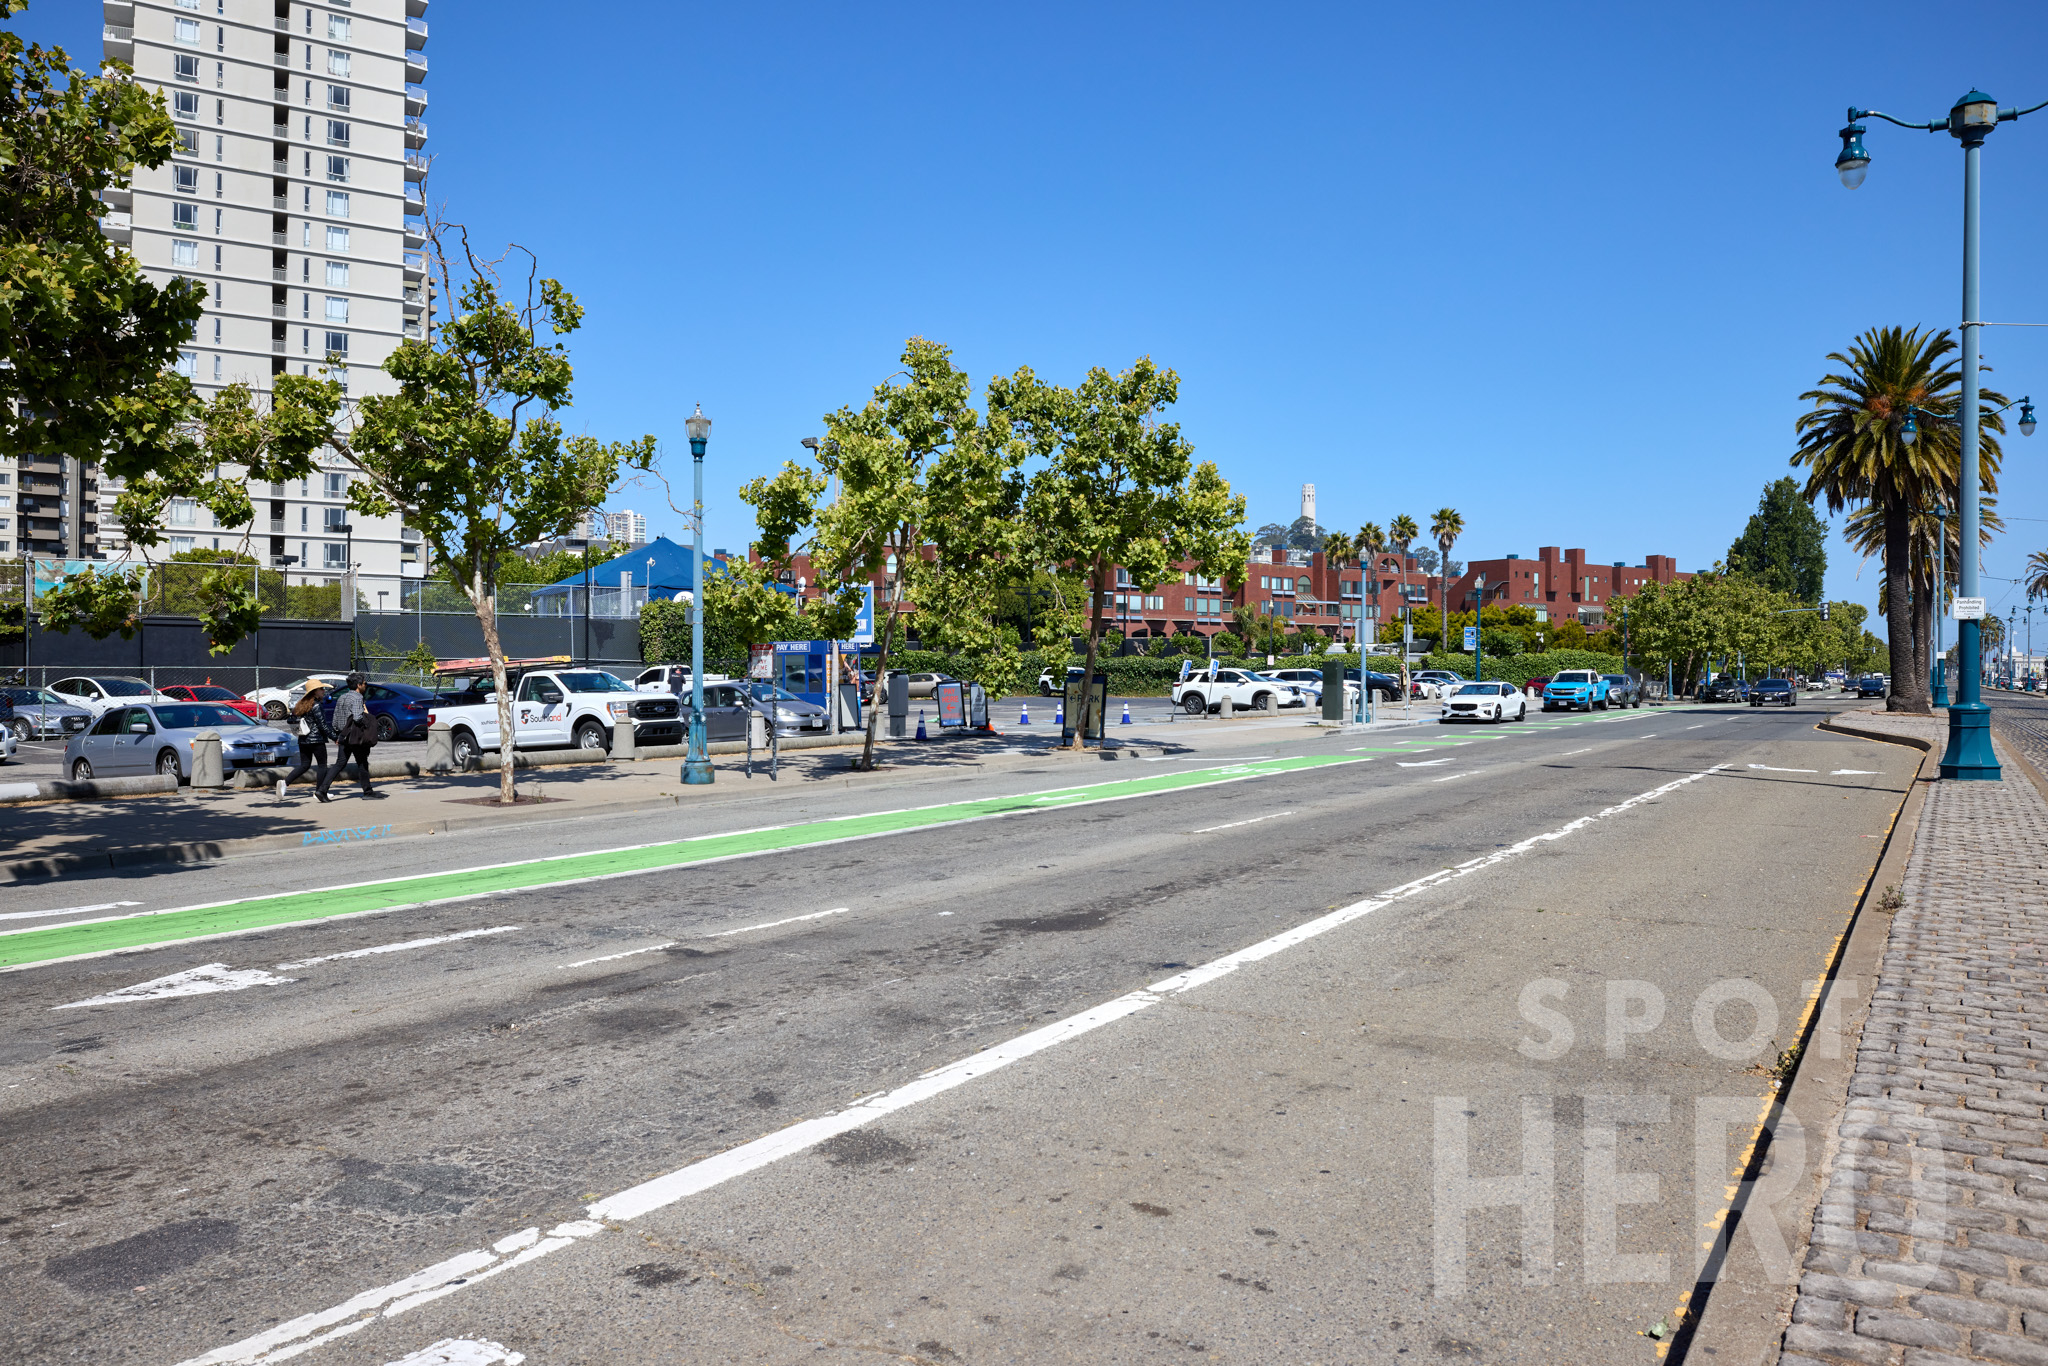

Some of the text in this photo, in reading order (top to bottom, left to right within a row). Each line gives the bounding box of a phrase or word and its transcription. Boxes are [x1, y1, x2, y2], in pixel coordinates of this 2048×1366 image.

[776, 643, 788, 651] PAY
[790, 643, 808, 651] HERE
[841, 642, 855, 650] HERE
[941, 695, 959, 703] HERE
[1077, 694, 1100, 703] PRK
[530, 712, 562, 723] Southland
